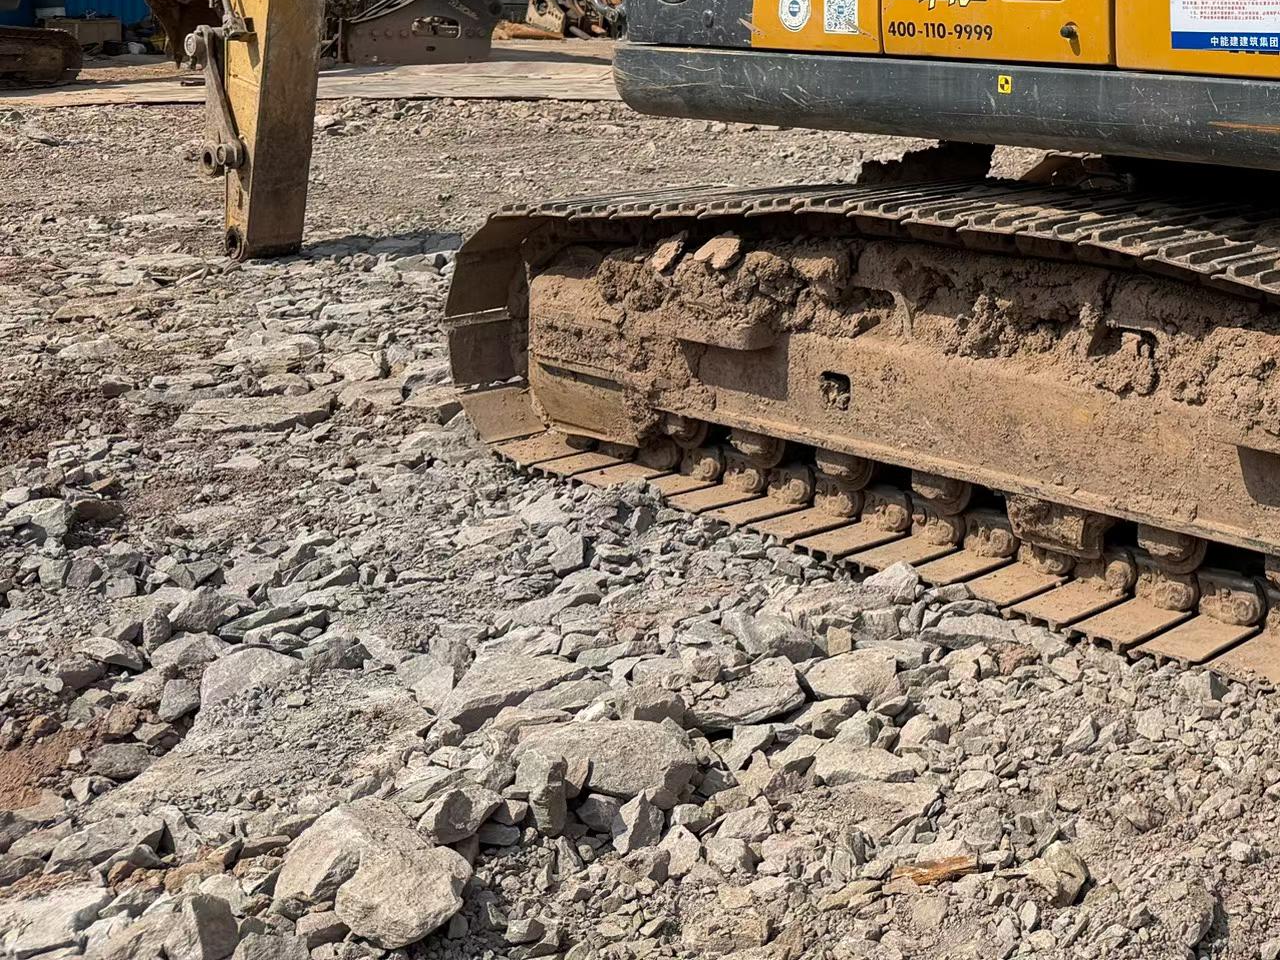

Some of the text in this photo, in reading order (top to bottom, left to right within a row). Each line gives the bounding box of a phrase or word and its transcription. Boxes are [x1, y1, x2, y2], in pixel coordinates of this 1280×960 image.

[888, 21, 993, 41] 400-110-9999
[1210, 35, 1279, 48] 中能建建筑集团
